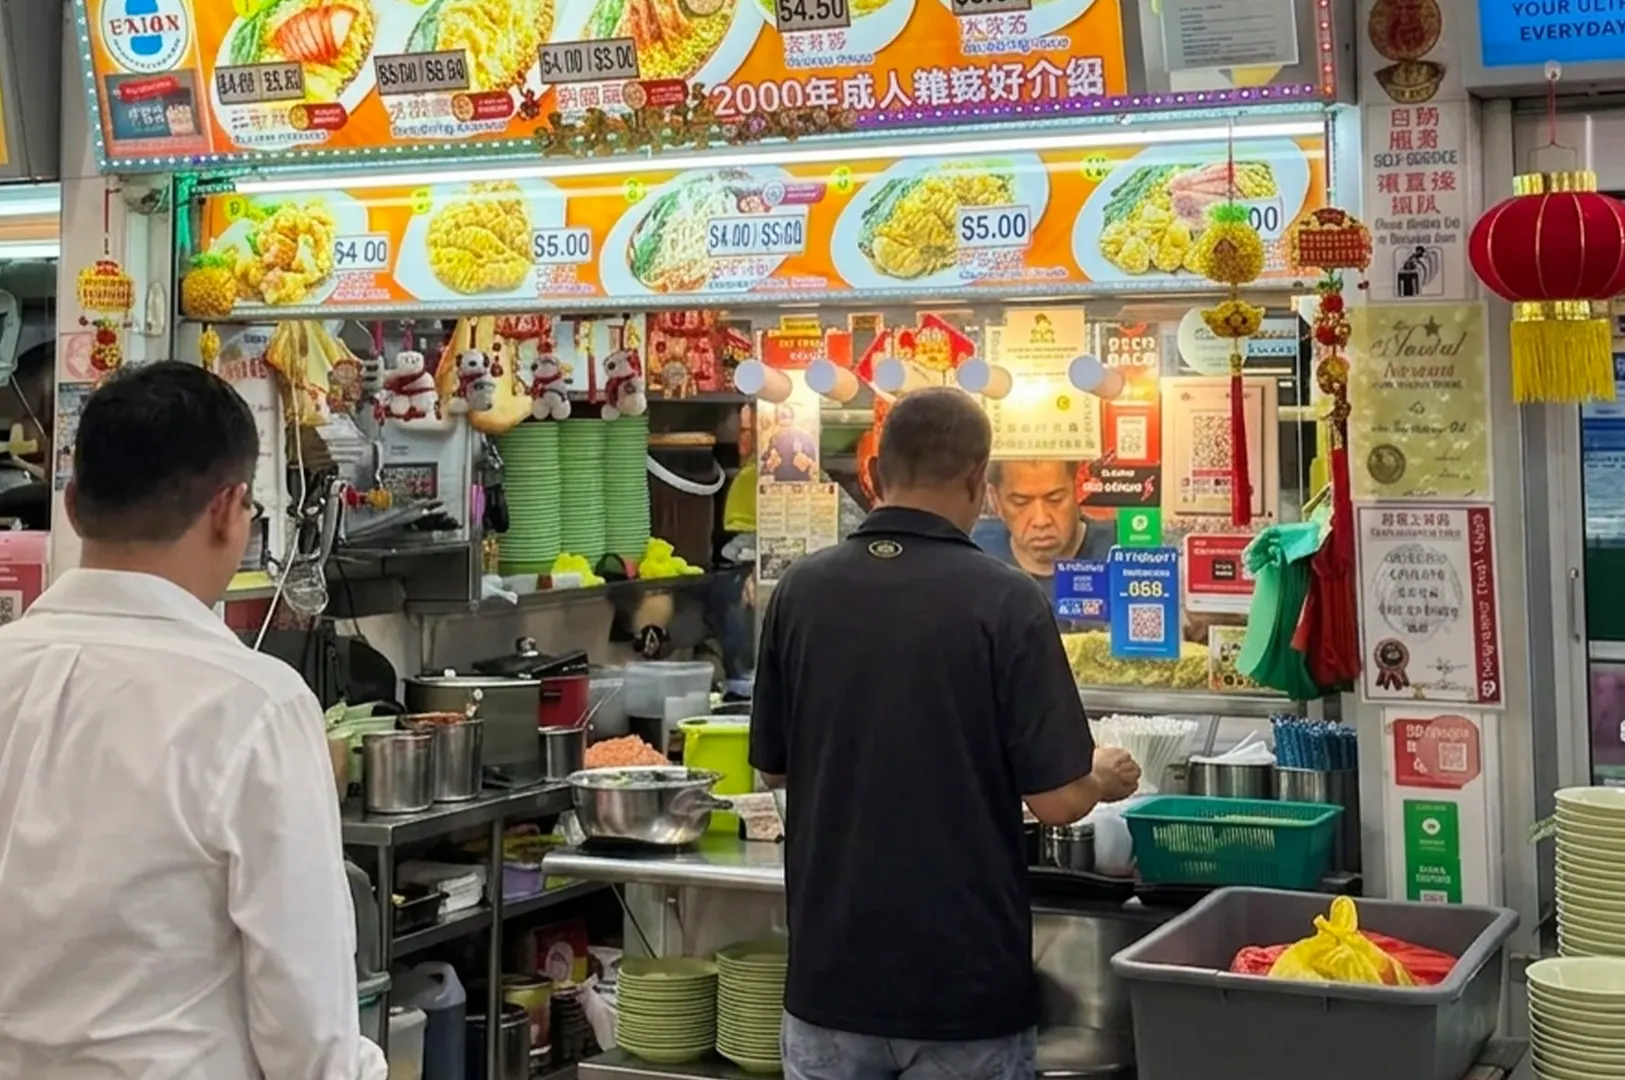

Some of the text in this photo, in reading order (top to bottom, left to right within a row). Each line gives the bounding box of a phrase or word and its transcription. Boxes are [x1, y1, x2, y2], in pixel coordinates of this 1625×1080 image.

[1511, 0, 1572, 17] YOUR
[1520, 19, 1625, 42] EVERYDAY
[961, 213, 1027, 241] $5.00
[533, 232, 590, 258] $5.00
